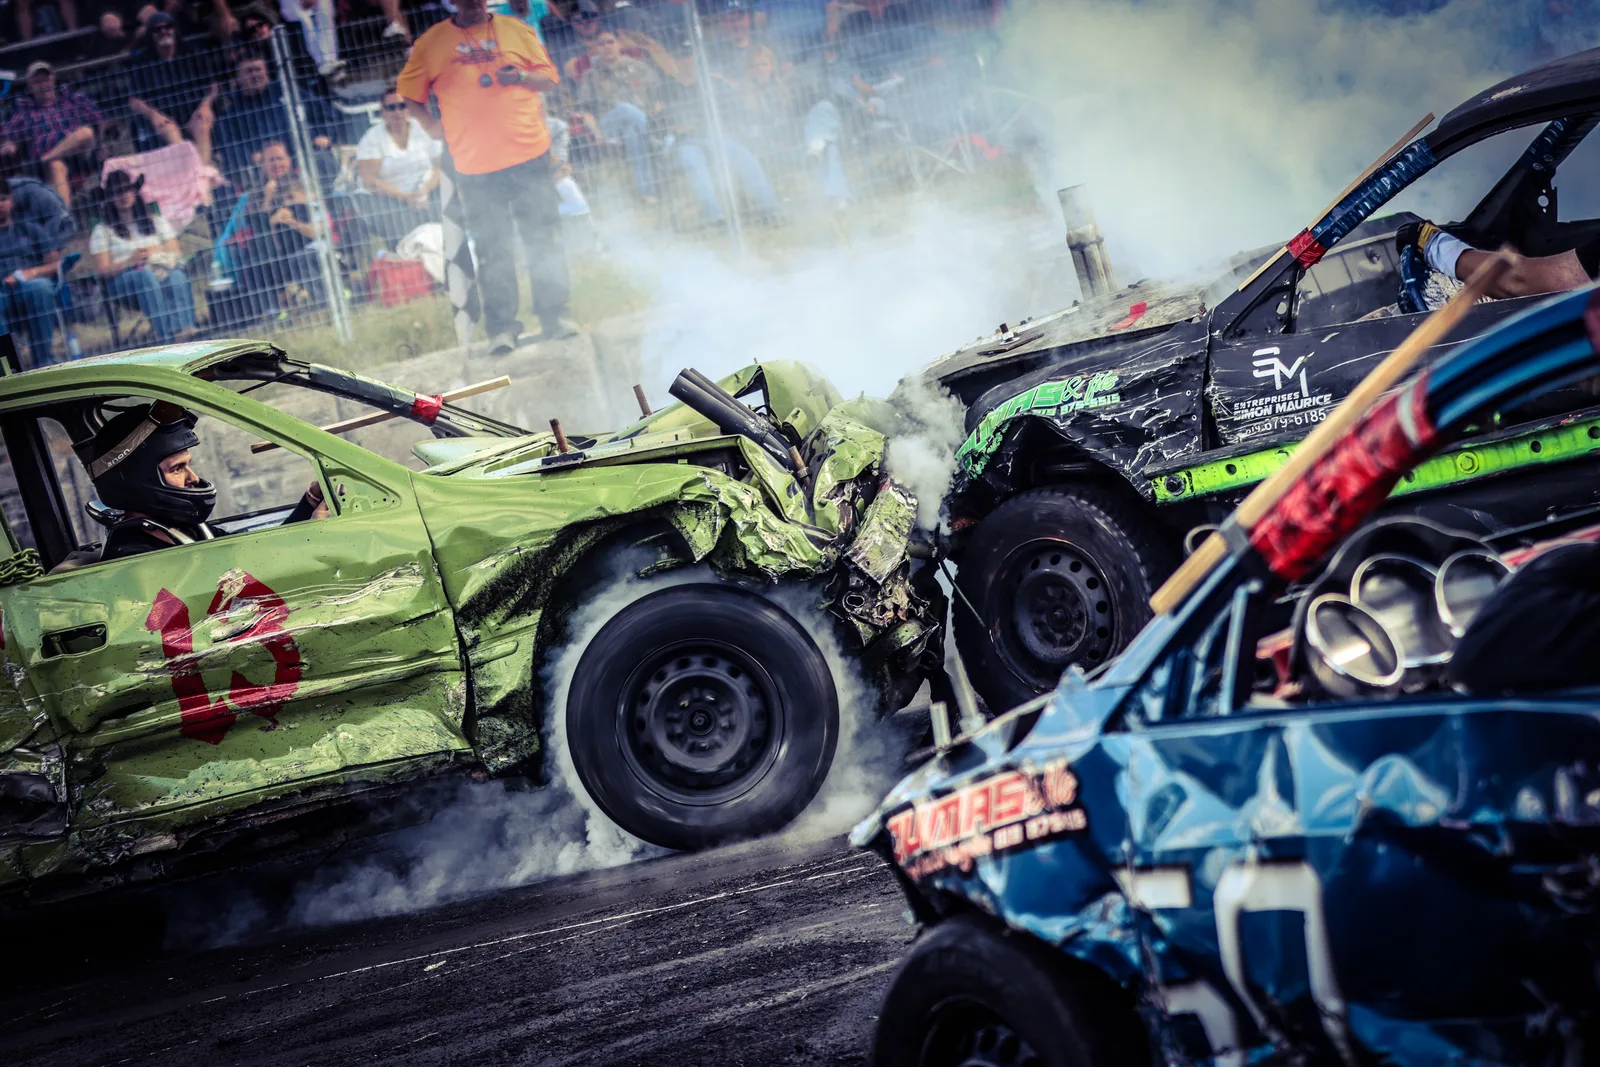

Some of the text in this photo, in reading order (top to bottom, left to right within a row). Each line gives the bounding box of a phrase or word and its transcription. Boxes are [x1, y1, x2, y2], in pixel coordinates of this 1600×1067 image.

[1062, 376, 1083, 401] &
[1234, 391, 1300, 411] ENTREPRISES
[1233, 393, 1333, 421] SIMON MAURICE
